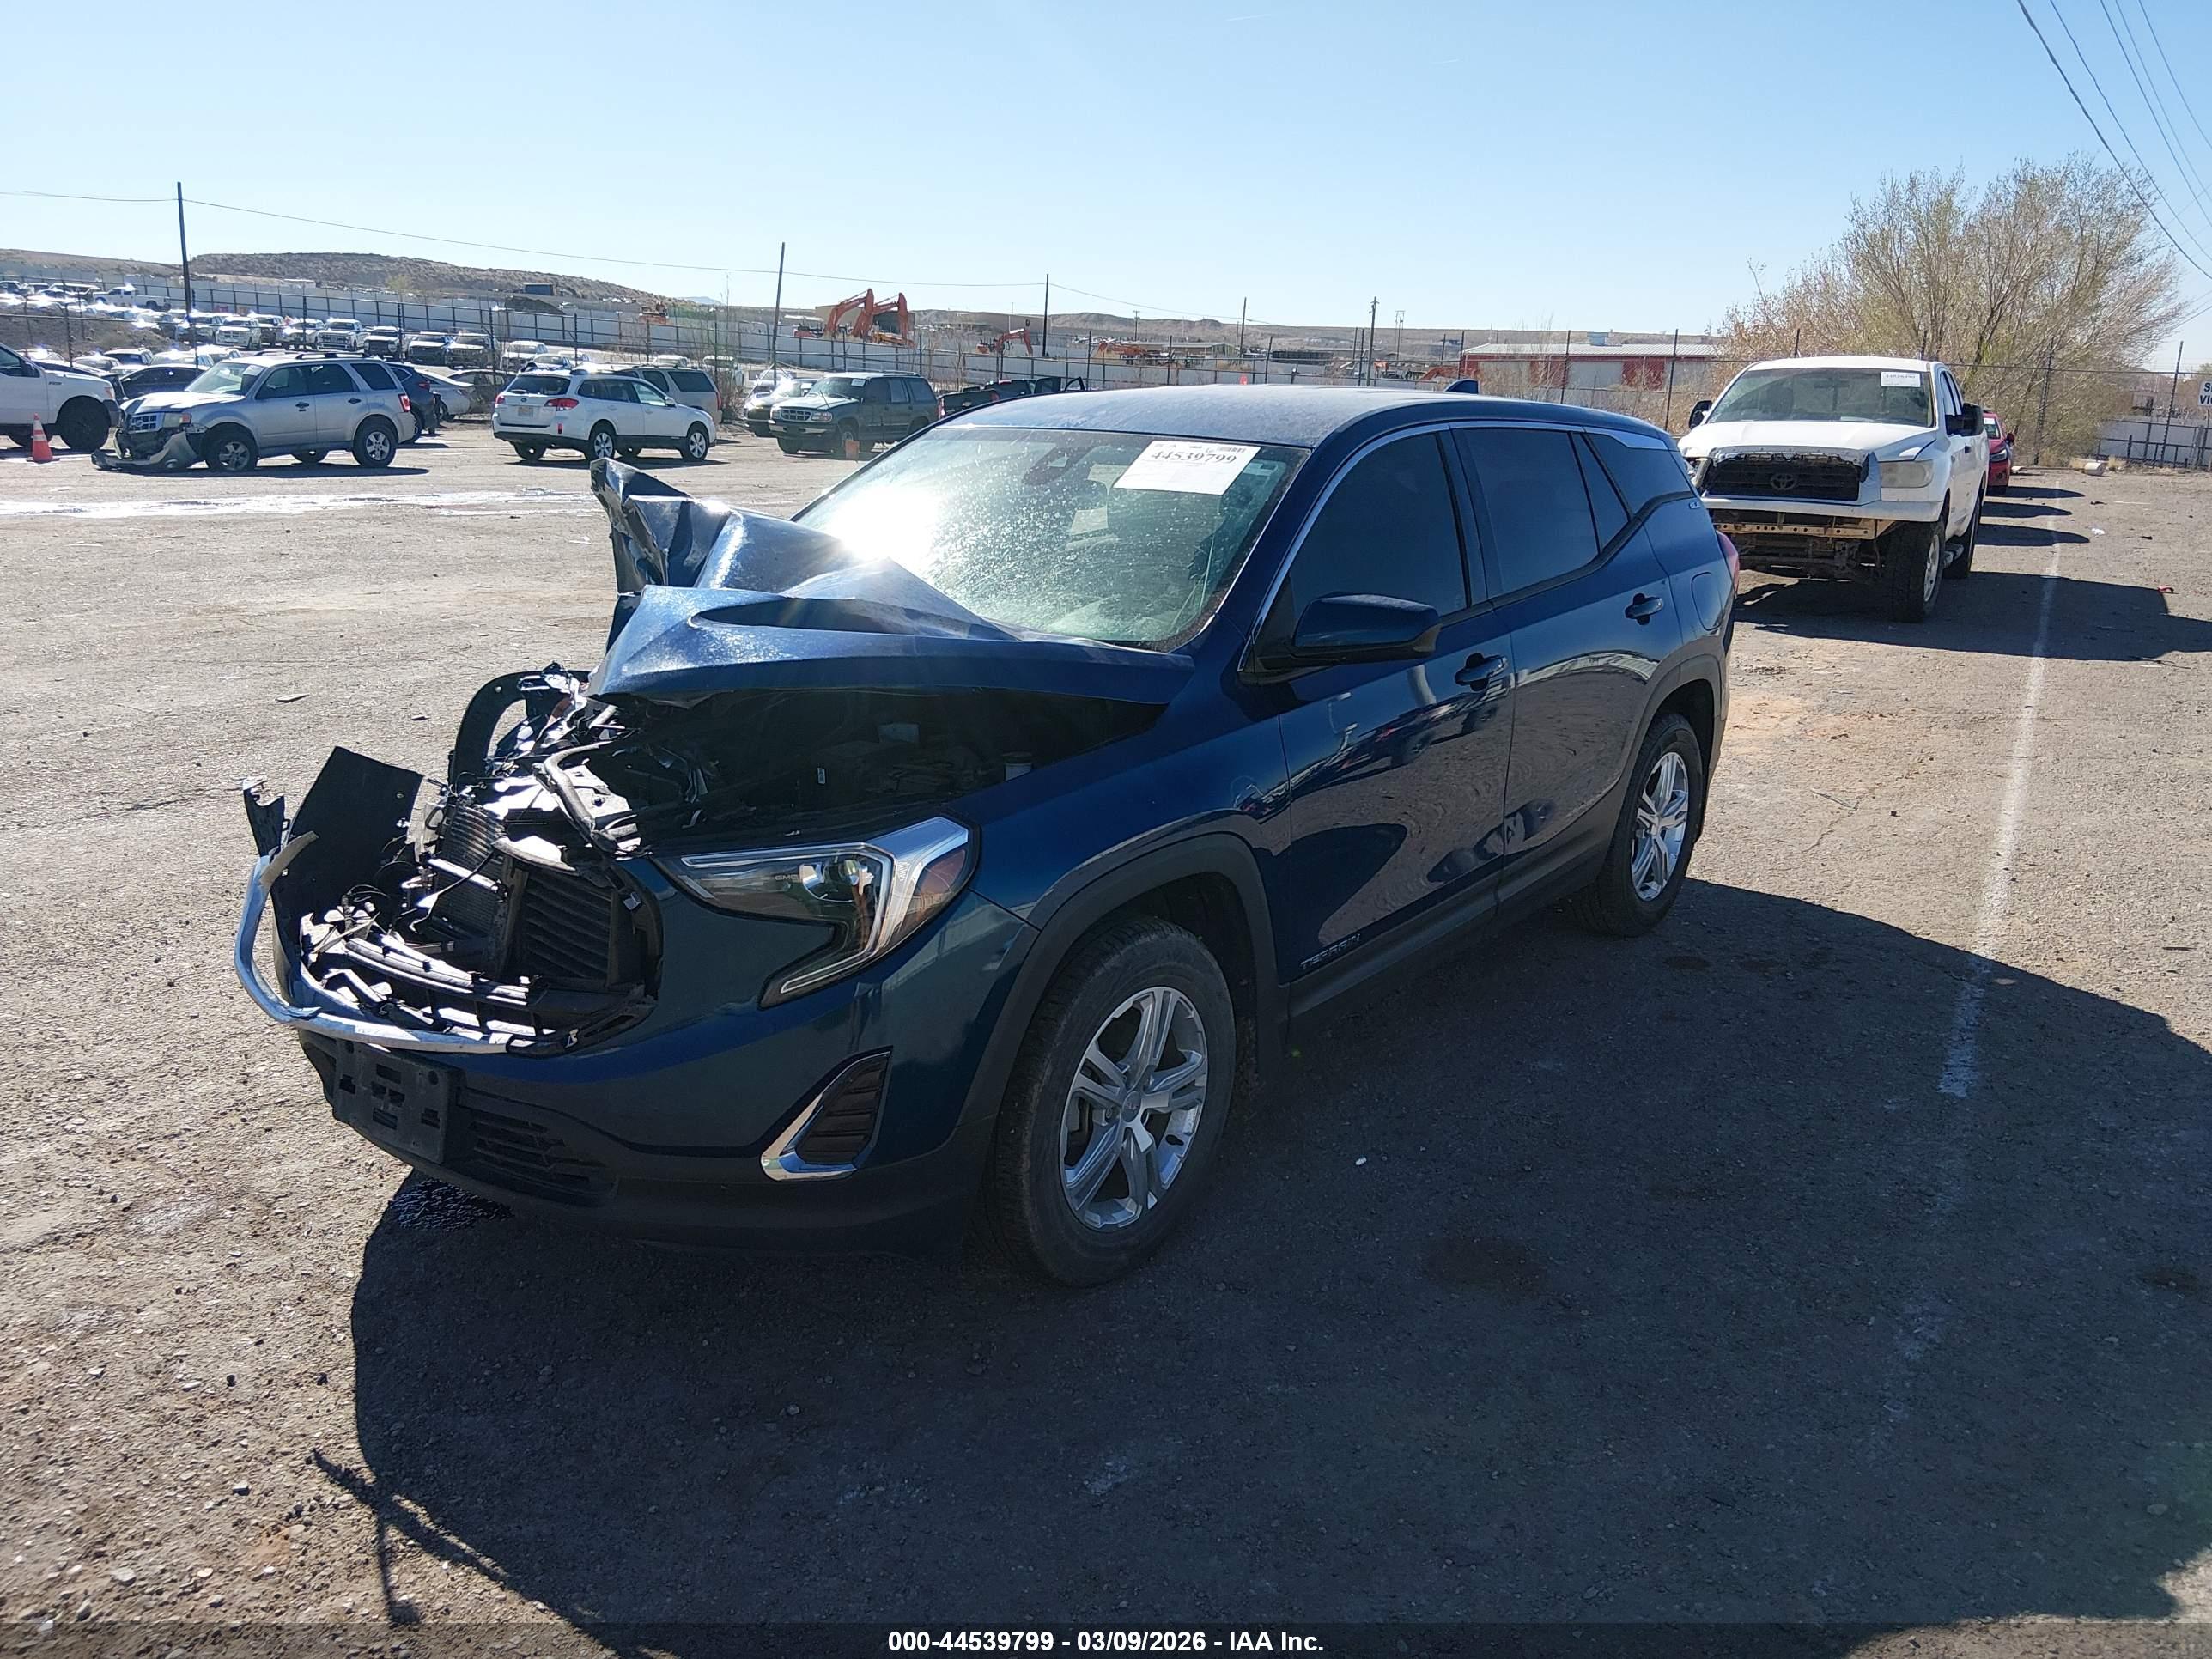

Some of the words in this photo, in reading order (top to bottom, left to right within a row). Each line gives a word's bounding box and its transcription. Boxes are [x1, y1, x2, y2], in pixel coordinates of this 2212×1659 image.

[2203, 382, 2212, 392] S
[2199, 394, 2212, 404] VI
[1151, 449, 1237, 464] 44539799
[1299, 933, 1361, 970] TERRAIN
